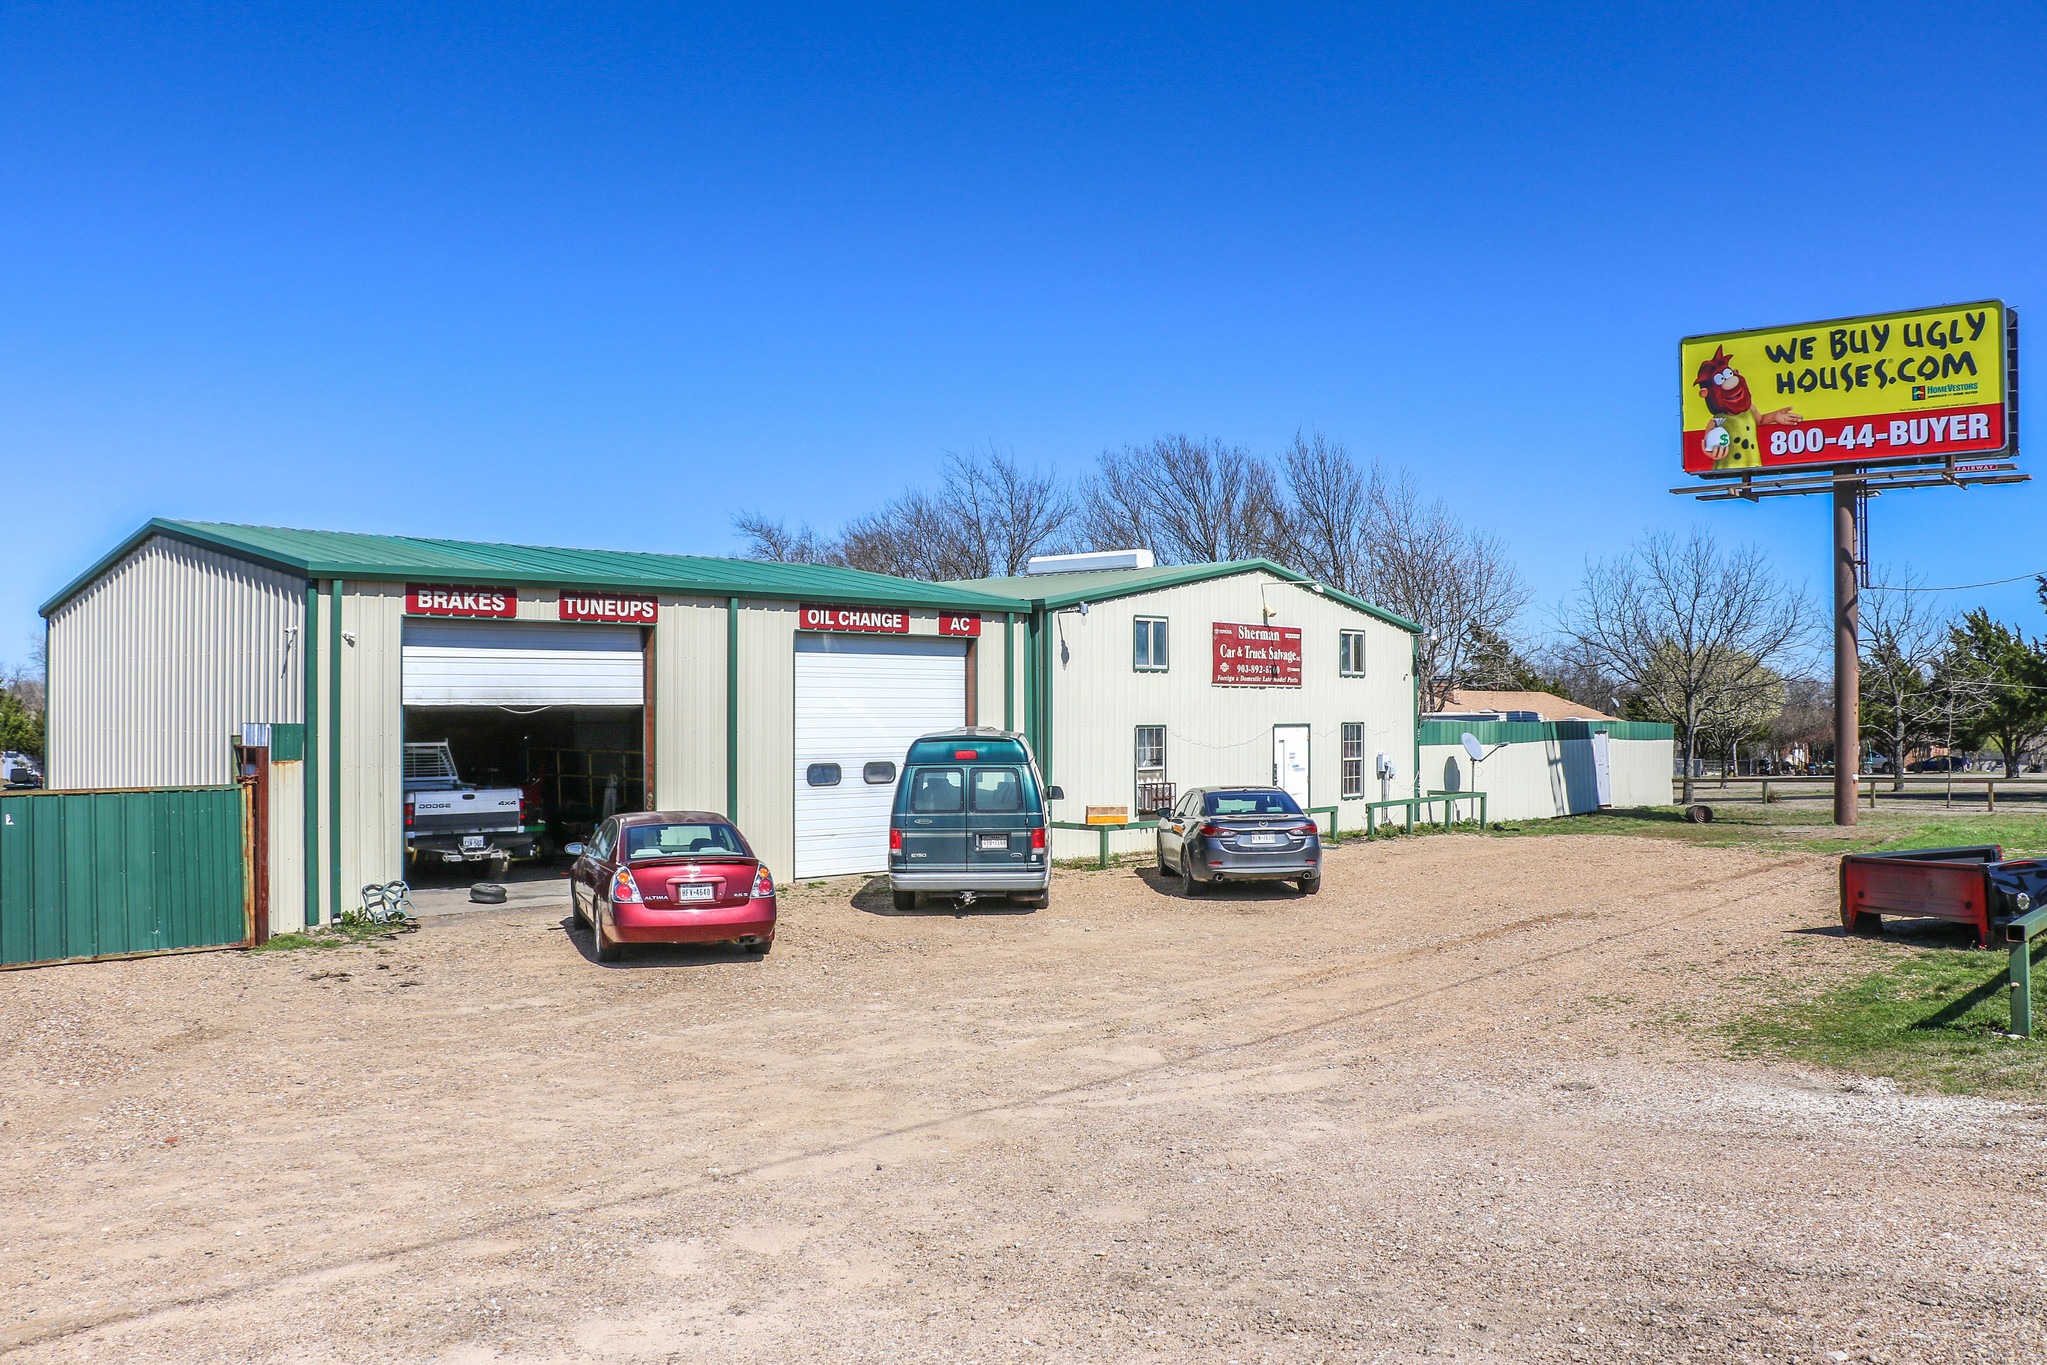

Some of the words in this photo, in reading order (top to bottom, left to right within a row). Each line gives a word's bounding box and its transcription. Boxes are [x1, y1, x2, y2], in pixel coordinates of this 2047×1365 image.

[1765, 336, 1817, 364] WE
[1829, 324, 1890, 360] BUY
[1903, 311, 1986, 349] UGLY
[1776, 351, 1978, 394] HOUSES.COM
[1770, 413, 1989, 455] 800-44-BUYER
[417, 590, 505, 611] BRAKES
[564, 598, 654, 617] TUNEUPS
[807, 609, 834, 624] OIL
[838, 611, 902, 628] CHANGE
[950, 617, 970, 631] AC
[1238, 626, 1280, 641] Sherman
[1220, 644, 1236, 658] Car
[1237, 646, 1243, 657] &
[1244, 645, 1267, 660] Truck
[1268, 647, 1297, 663] Salvage
